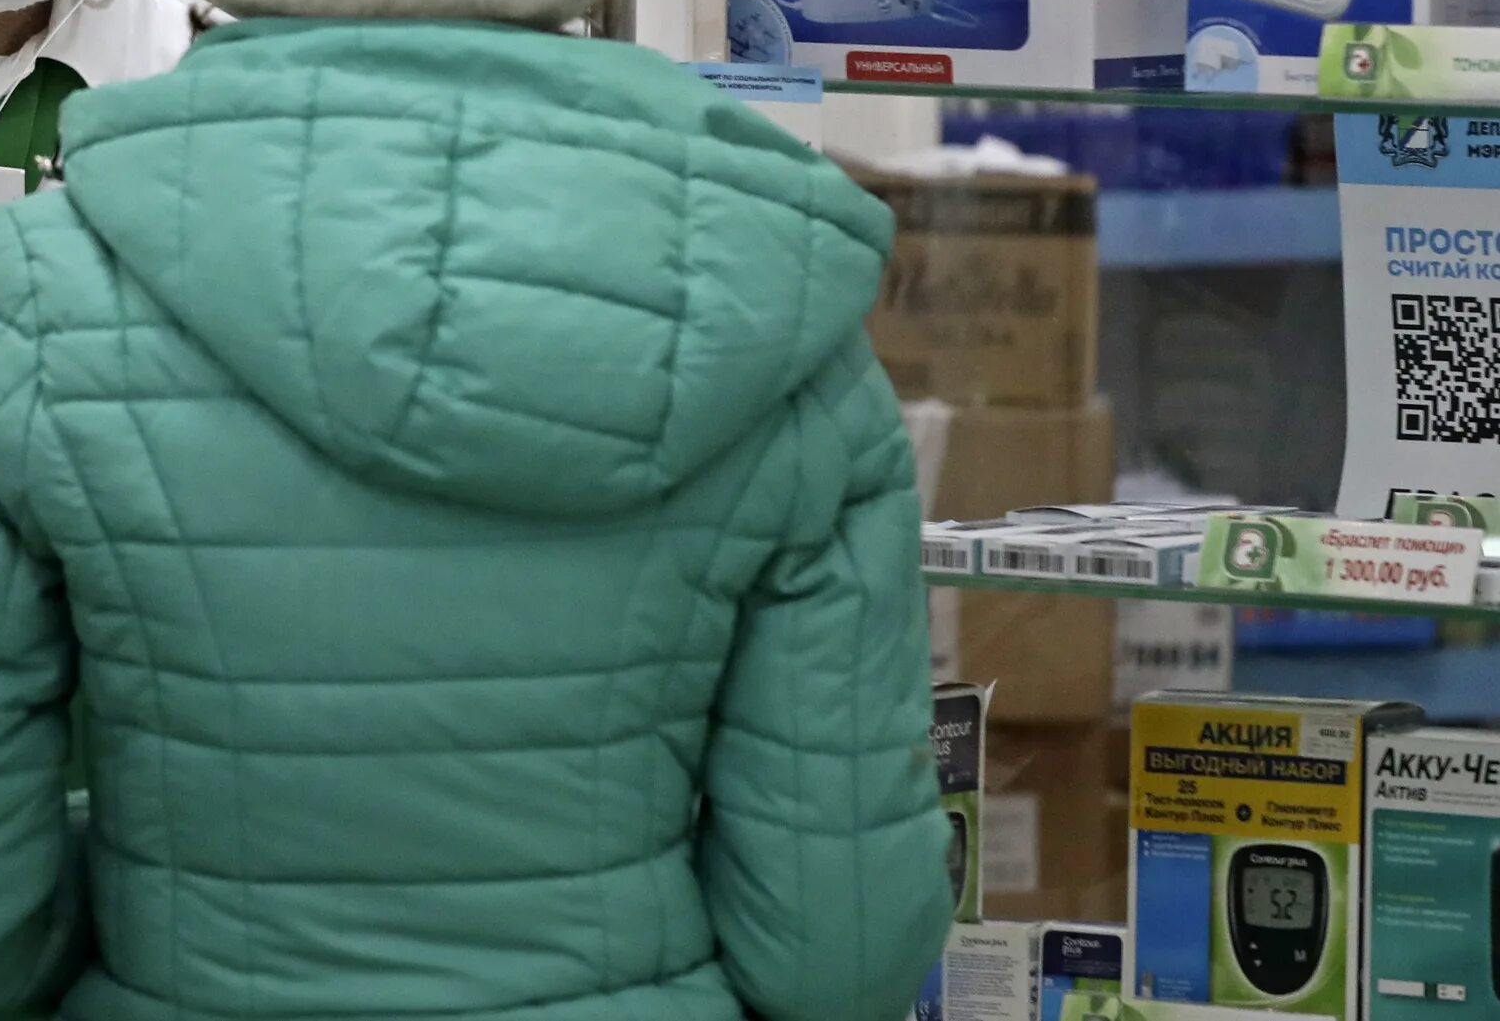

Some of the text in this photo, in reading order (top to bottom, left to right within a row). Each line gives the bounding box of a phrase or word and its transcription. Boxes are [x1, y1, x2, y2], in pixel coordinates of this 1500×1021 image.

[855, 61, 944, 74] УНИВЕРСАЛЬНЫЙ
[1386, 226, 1500, 256] ПРОСТ
[1388, 258, 1470, 278] СЧИТАЙ
[1324, 560, 1449, 592] 1 300,00 руб.
[1199, 723, 1293, 751] АКЦИЯ
[1150, 752, 1342, 780] ВЫГОДНЫЙ НАБОР
[1178, 781, 1198, 794] 25
[1144, 808, 1226, 824] Контур Плюс
[1261, 815, 1343, 831] Контур Плюс
